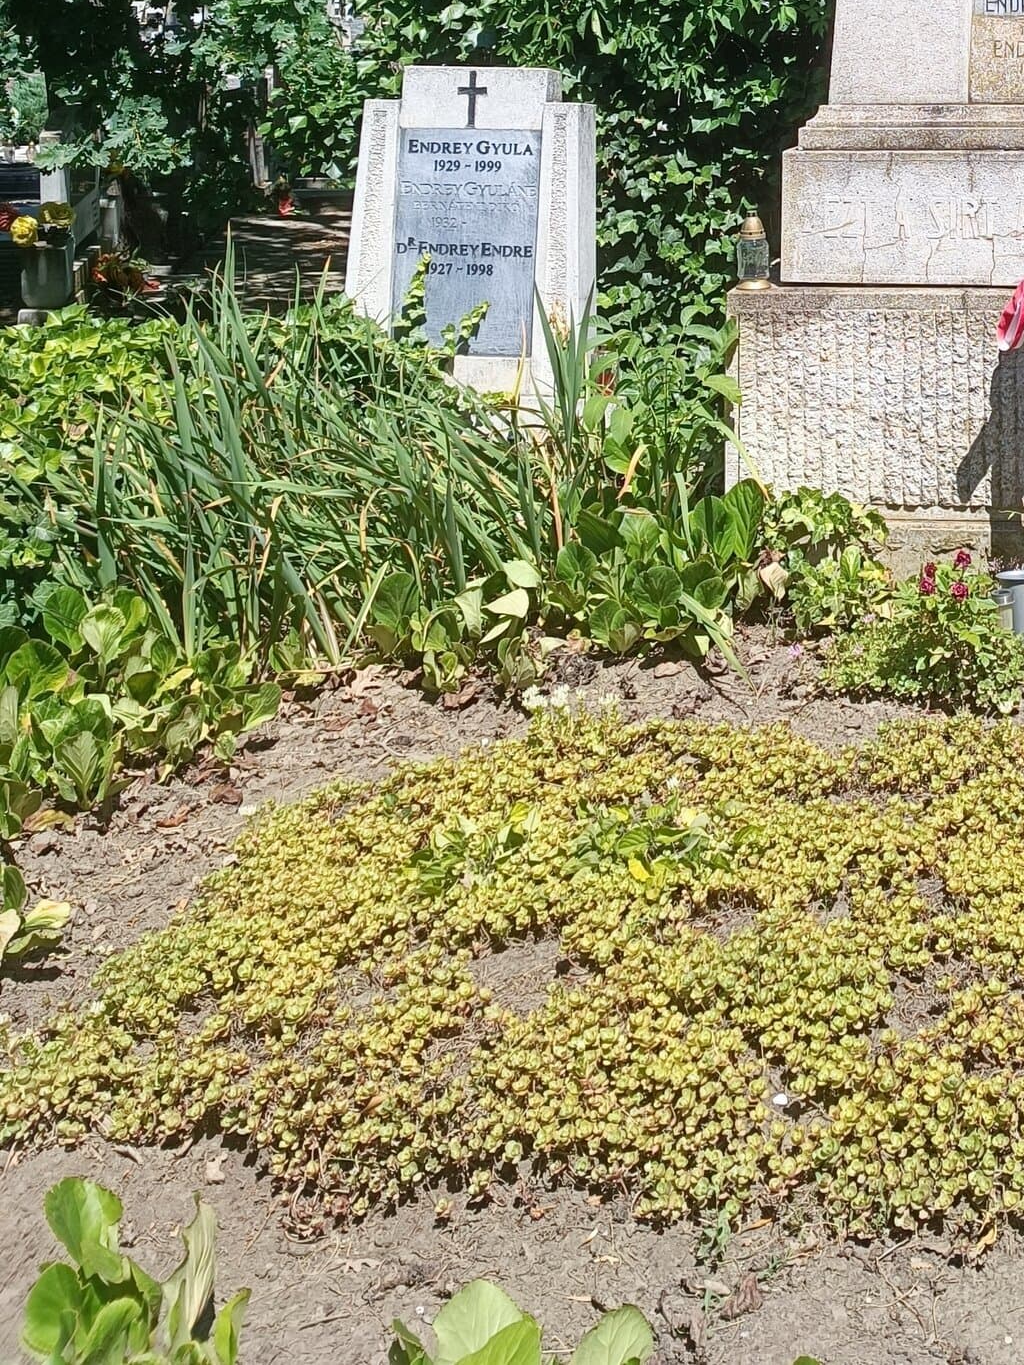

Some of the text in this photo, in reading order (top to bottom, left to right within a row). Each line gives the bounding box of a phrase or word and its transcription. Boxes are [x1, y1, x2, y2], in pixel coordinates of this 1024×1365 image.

[408, 139, 533, 156] ENDREY GYULA
[400, 180, 463, 196] ENDREY
[481, 242, 533, 258] ENDRE
